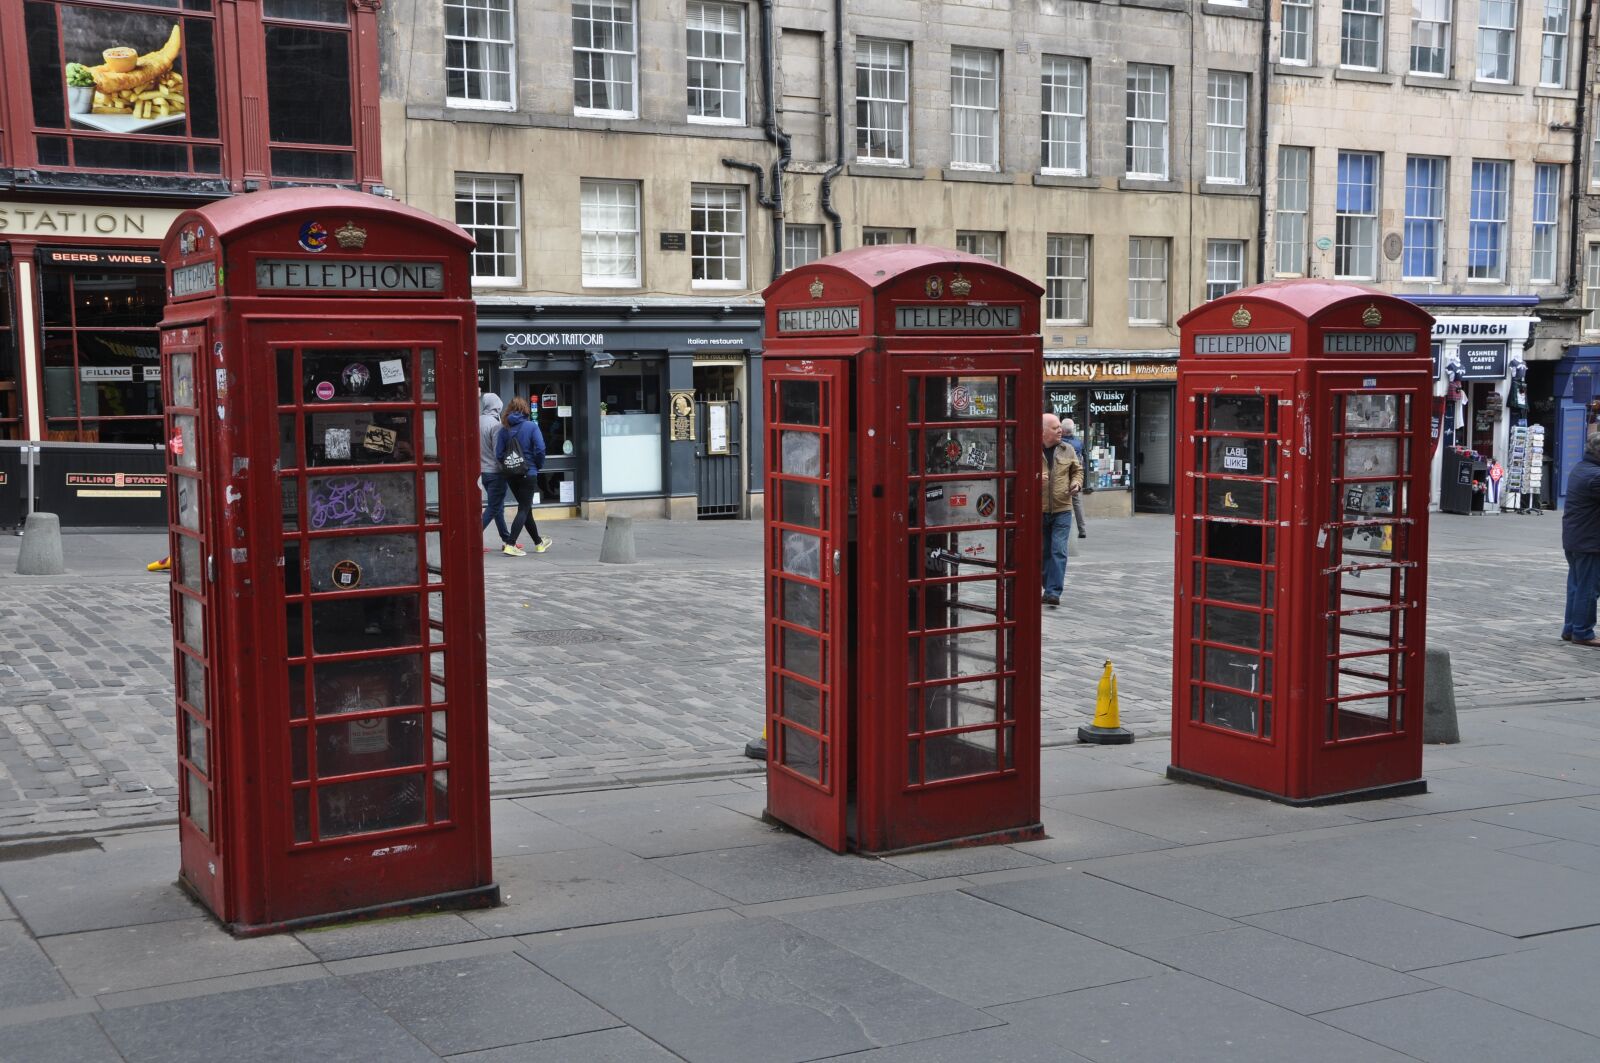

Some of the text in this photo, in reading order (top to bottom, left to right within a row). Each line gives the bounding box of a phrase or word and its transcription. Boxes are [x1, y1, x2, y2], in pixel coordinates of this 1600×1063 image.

[52, 253, 152, 263] BEERS WINES
[175, 263, 216, 294] TELEPHONE
[262, 262, 436, 289] TELEPHONE
[782, 308, 858, 331] TELEPHONE
[899, 307, 1016, 328] TELEPHONE
[1431, 324, 1508, 335] DINBURGH
[505, 332, 604, 345] GORDON'S TRATTORIA
[1199, 334, 1288, 354] TELEPHONE
[1324, 334, 1413, 353] TELEPHONE
[1045, 360, 1131, 380] Whisky Trail
[1135, 364, 1160, 376] Whisky
[1050, 391, 1077, 404] Single
[1094, 391, 1125, 403] Whisky
[1053, 403, 1073, 413] Malt
[1089, 402, 1129, 415] Specialist
